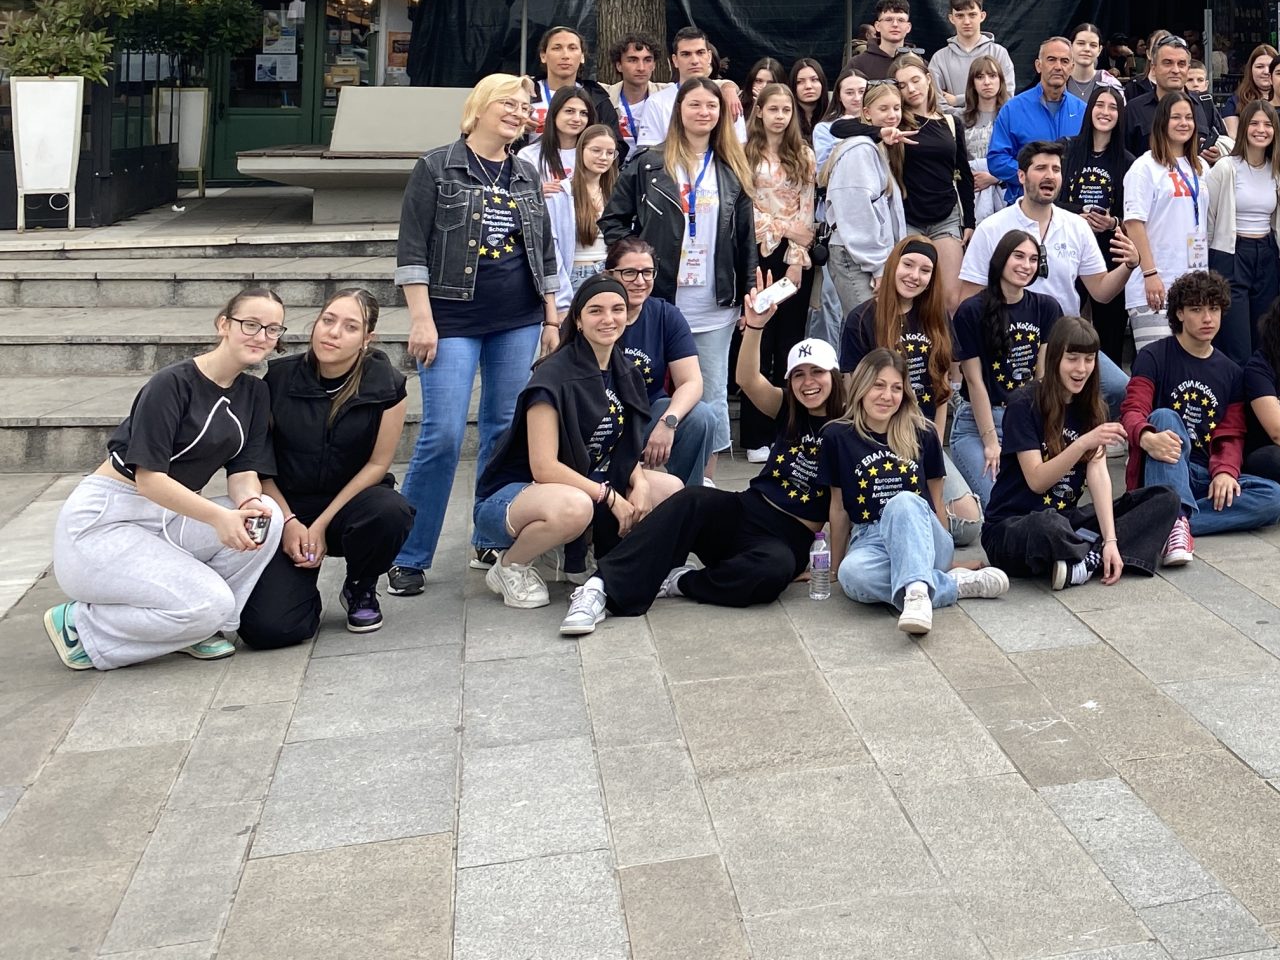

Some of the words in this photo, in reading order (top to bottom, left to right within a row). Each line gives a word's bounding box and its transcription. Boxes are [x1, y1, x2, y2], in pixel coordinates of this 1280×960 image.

[485, 207, 511, 215] European
[483, 213, 513, 222] Parliament
[481, 220, 515, 228] Ambassador
[624, 347, 652, 365] Κοζάνης
[861, 450, 885, 467] ΕΠΑΛ
[874, 476, 902, 484] European
[873, 483, 903, 492] Parliament
